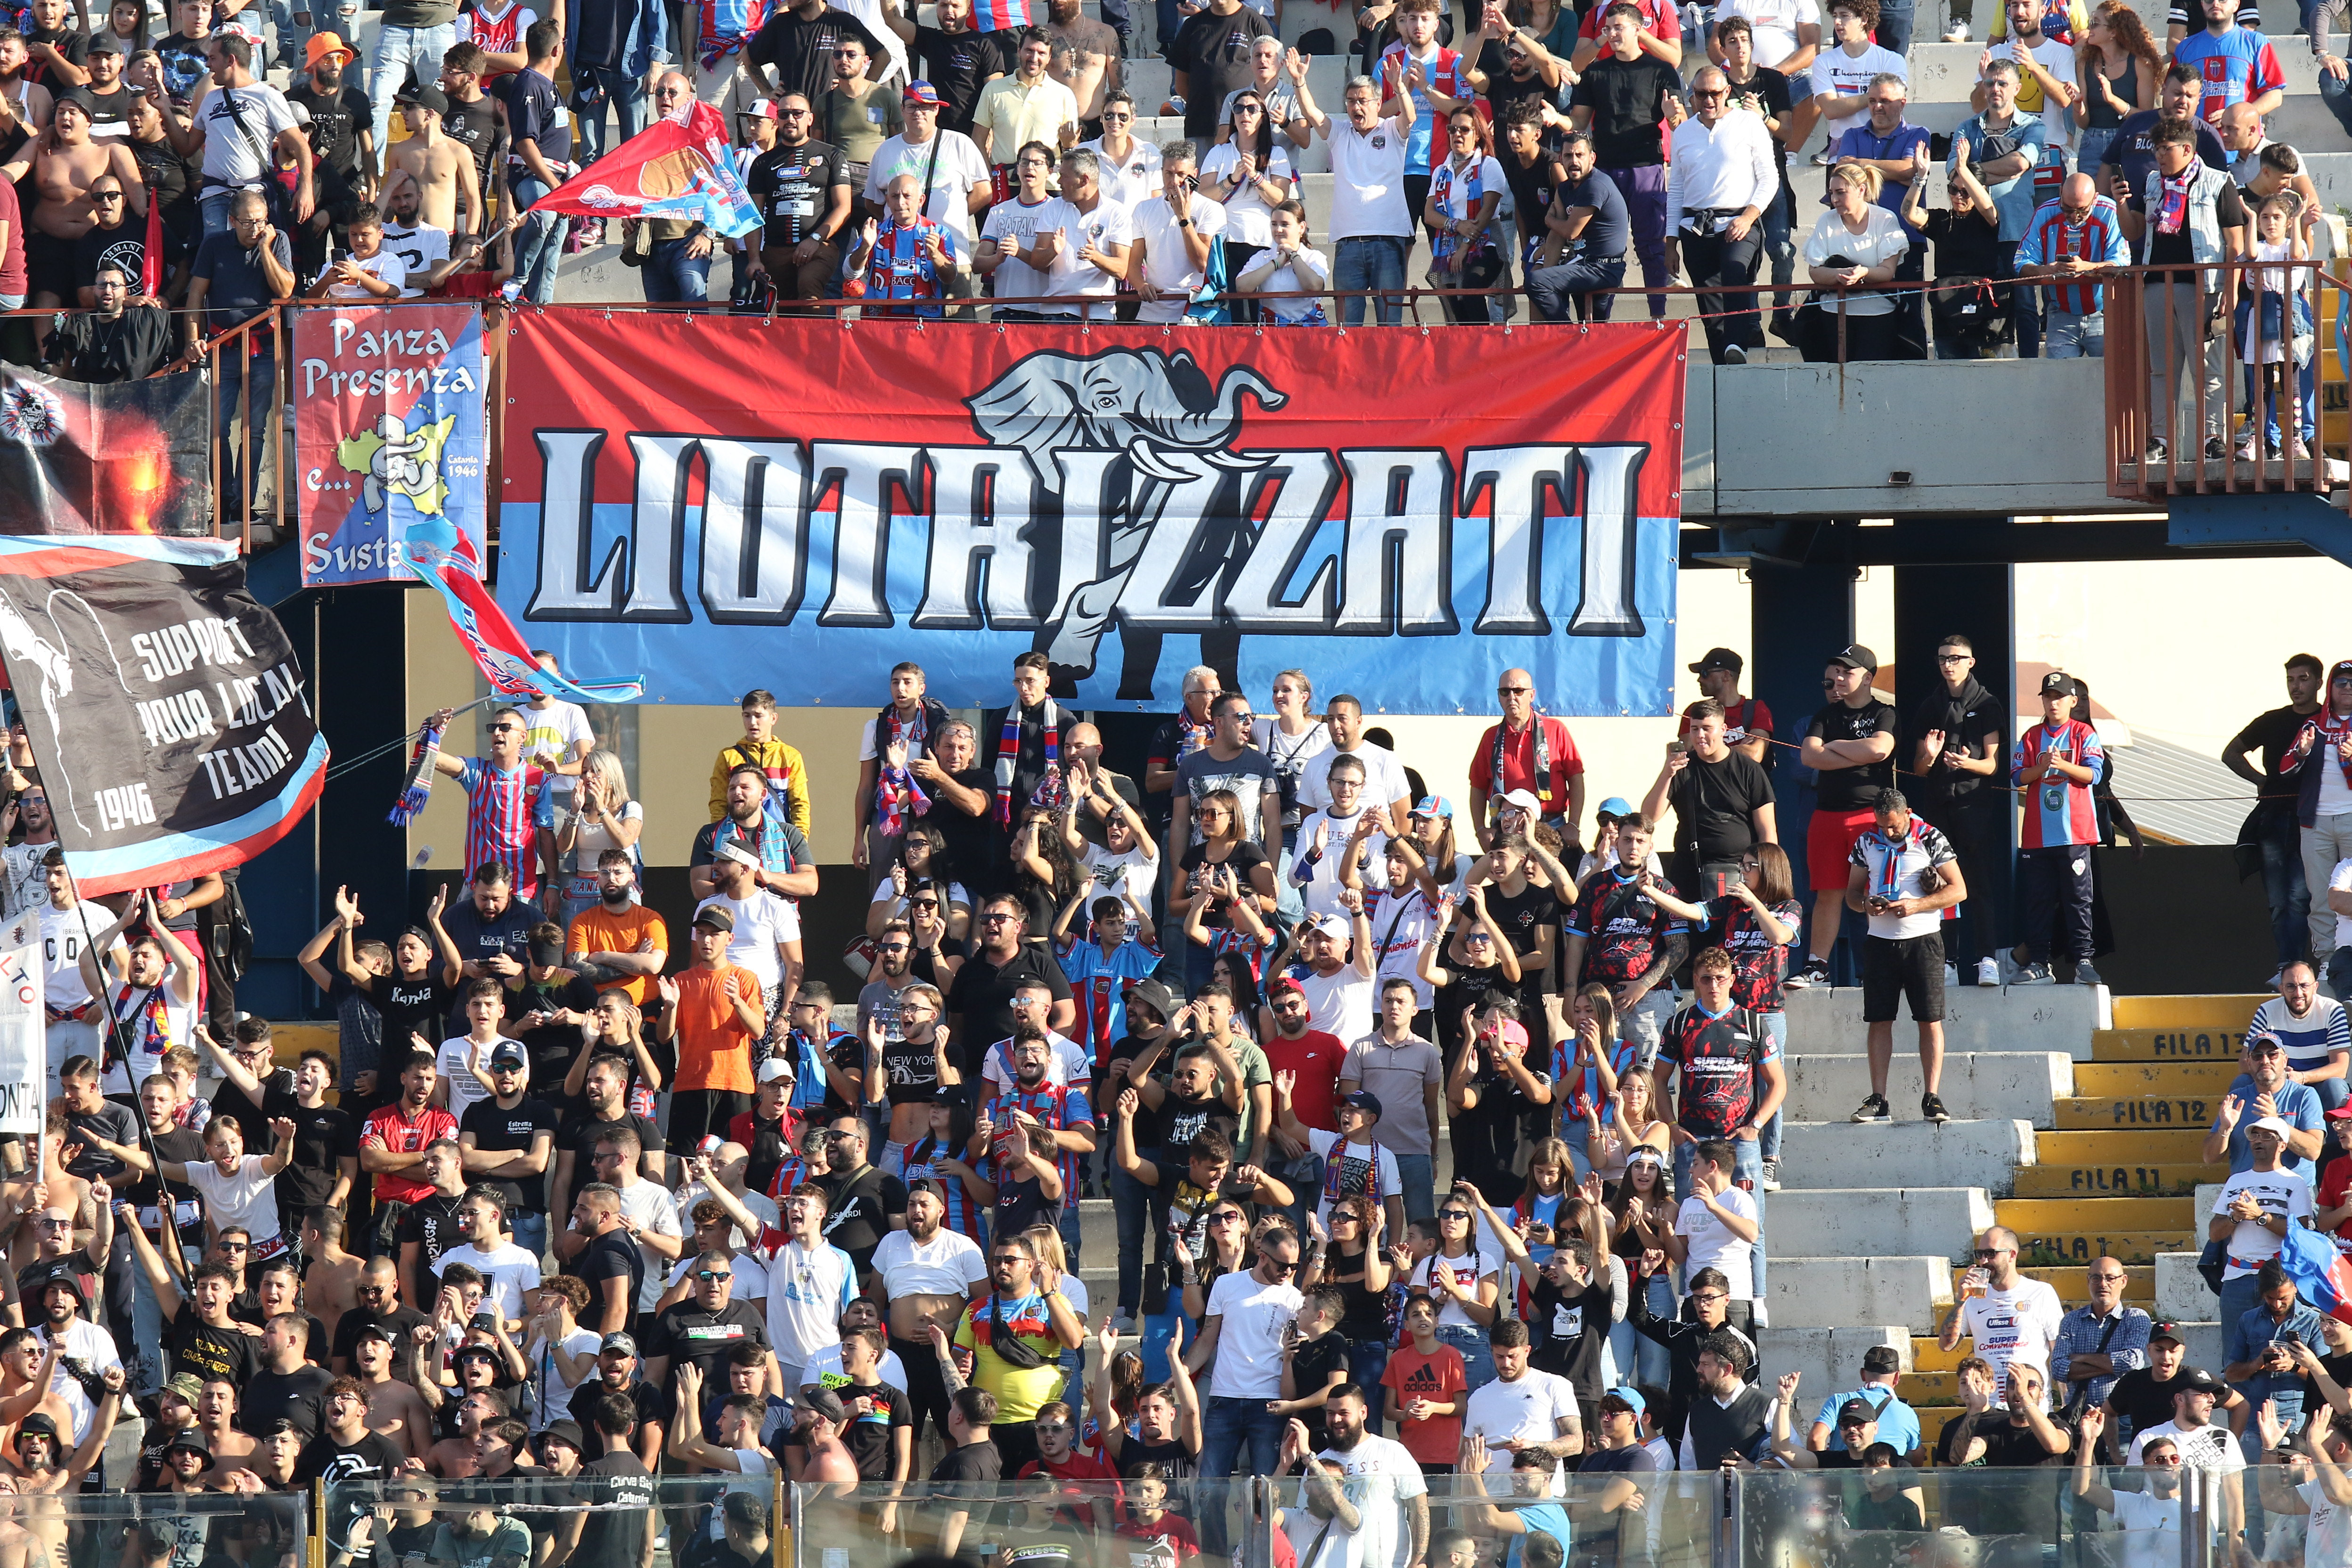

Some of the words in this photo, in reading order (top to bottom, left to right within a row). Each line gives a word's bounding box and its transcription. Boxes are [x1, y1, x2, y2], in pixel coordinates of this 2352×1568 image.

[2207, 81, 2238, 90] Energia
[2207, 88, 2239, 97] Siciliana
[102, 242, 142, 259] ARMANI
[891, 276, 915, 286] BACC
[329, 318, 451, 358] Panza
[300, 358, 477, 399] Presenza
[447, 453, 479, 465] Catania
[447, 464, 479, 478] 1946
[523, 426, 1651, 638] LIOTRIZZATI
[131, 616, 256, 682] SUPPORT
[135, 688, 218, 747] YOUR
[197, 723, 294, 800] TEAM!
[94, 782, 157, 832] 1946
[2154, 1034, 2211, 1056] FILA
[886, 1055, 912, 1067] NEW
[915, 1055, 936, 1066] YOR
[1693, 1056, 1735, 1065] SUPER
[1683, 1063, 1749, 1073] Conveniente
[2114, 1100, 2171, 1123] FILA
[2180, 1100, 2207, 1122] 12
[2071, 1168, 2128, 1190] FILA
[2136, 1168, 2160, 1189] 11
[1987, 1319, 2009, 1327] Ulisse
[1979, 1341, 2029, 1351] Conveniente
[1989, 1336, 2018, 1344] SUPER
[823, 1373, 838, 1383] BOY
[1404, 1382, 1442, 1392] adidas
[2187, 1434, 2210, 1452] THE
[1019, 1546, 1056, 1557] GUESS
